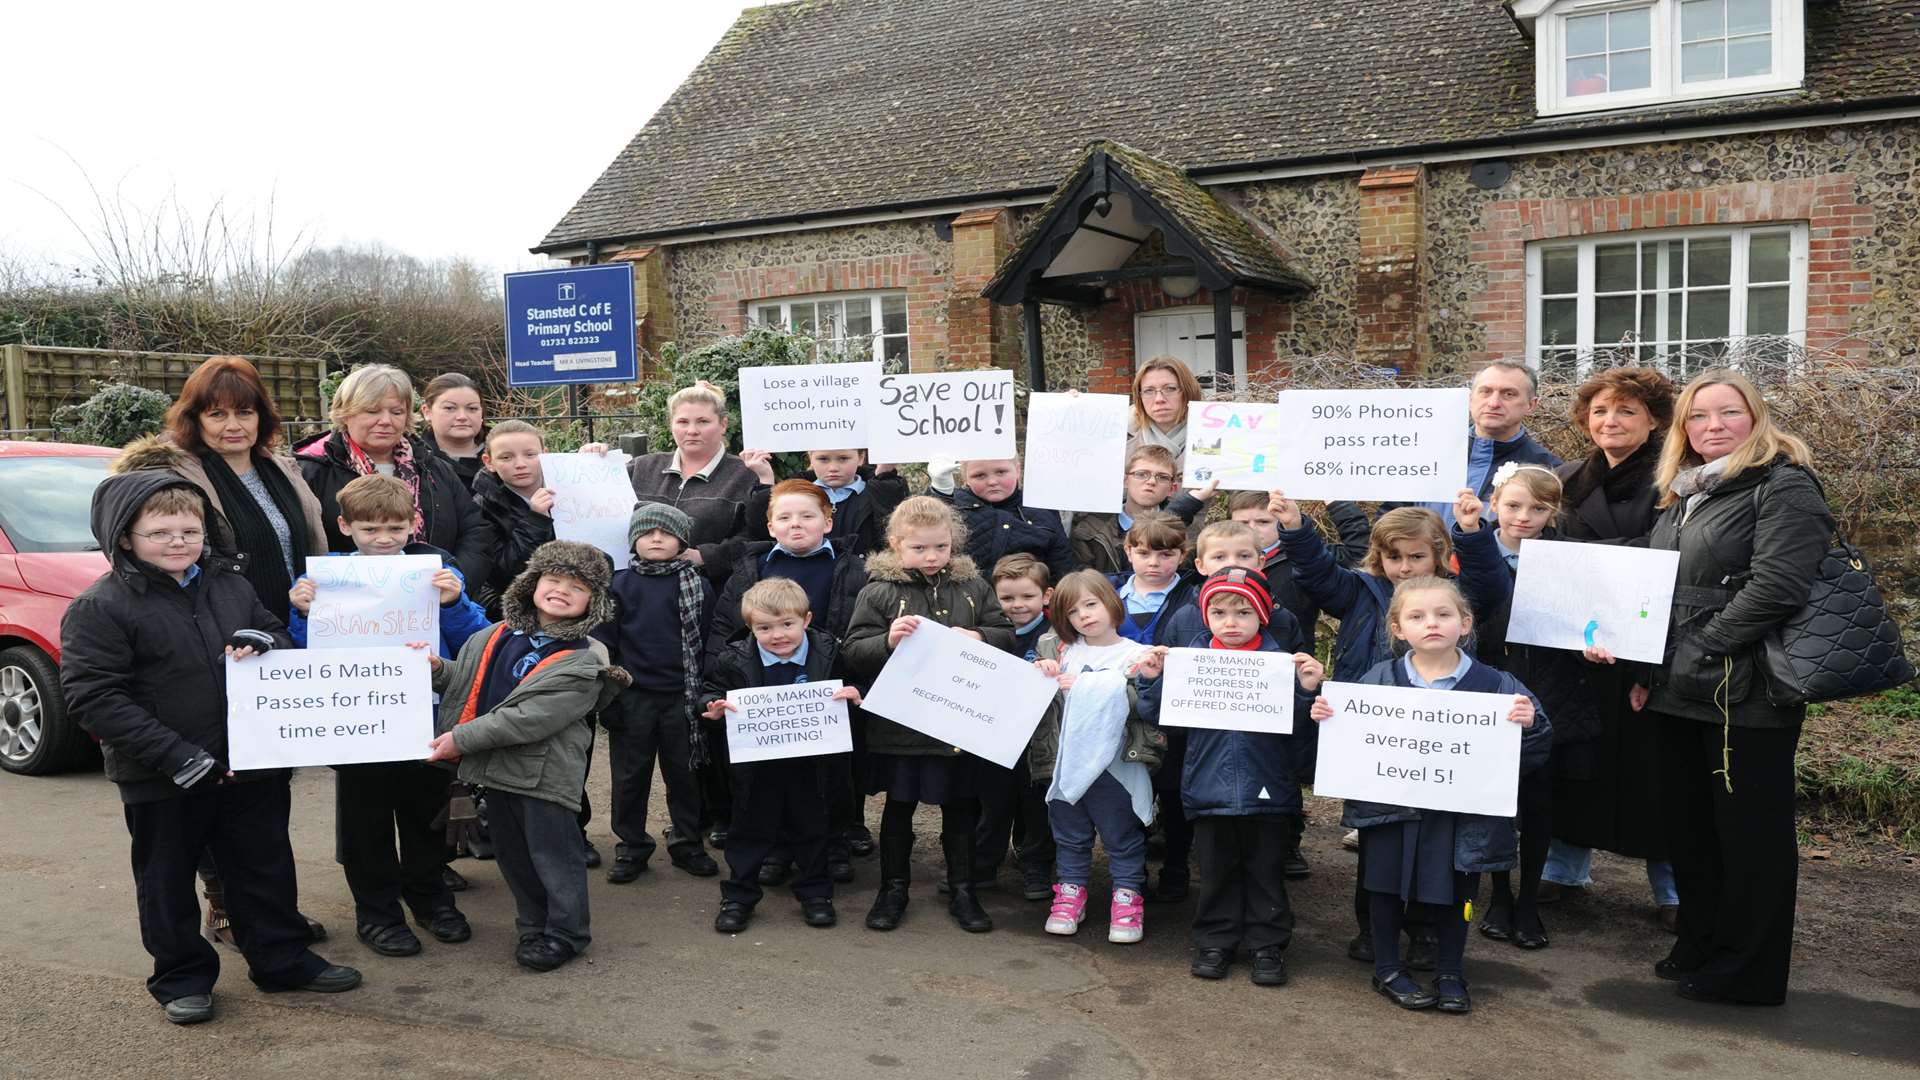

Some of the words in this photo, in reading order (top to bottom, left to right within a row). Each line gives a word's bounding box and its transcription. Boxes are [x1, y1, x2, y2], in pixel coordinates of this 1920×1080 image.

[527, 304, 576, 320] Stansted
[579, 304, 588, 316] C
[590, 303, 602, 315] of
[604, 302, 611, 315] E
[527, 322, 571, 337] Primary
[574, 319, 613, 333] School
[540, 337, 566, 347] 01732
[568, 336, 600, 345] 822323
[763, 378, 796, 390] Lose
[801, 379, 809, 388] a
[813, 375, 860, 389] village
[879, 376, 951, 406] Save
[963, 381, 1011, 402] our
[764, 397, 816, 412] school,
[820, 397, 849, 408] ruin
[854, 398, 862, 407] a
[1311, 405, 1352, 419] 90%
[1359, 404, 1433, 419] Phonics
[772, 418, 857, 432] community
[1324, 434, 1366, 450] pass
[1372, 432, 1419, 447] rate!
[1303, 461, 1344, 476] 68%
[1350, 461, 1438, 476] increase!
[959, 650, 998, 671] ROBBED
[1193, 655, 1216, 664] 48%
[1219, 656, 1265, 667] MAKING
[259, 664, 312, 681] Level
[320, 664, 332, 679] 6
[339, 662, 403, 678] Maths
[1197, 666, 1260, 678] EXPECTED
[951, 675, 965, 684] OF
[966, 680, 982, 691] MY
[1188, 676, 1254, 689] PROGRESS
[1257, 681, 1269, 690] IN
[256, 695, 325, 710] Passes
[331, 692, 361, 707] for
[367, 691, 407, 706] first
[737, 693, 773, 705] 100%
[776, 687, 833, 702] MAKING
[1193, 689, 1244, 700] WRITING
[1246, 692, 1263, 701] AT
[747, 702, 825, 720] EXPECTED
[911, 687, 965, 713] RECEPTION
[964, 704, 995, 725] PLACE
[1171, 698, 1227, 711] OFFERED
[1230, 702, 1283, 714] SCHOOL!
[1344, 699, 1406, 719] Above
[1412, 709, 1497, 727] national
[279, 723, 326, 739] time
[334, 719, 386, 737] ever!
[738, 716, 820, 734] PROGRESS
[824, 714, 838, 725] IN
[756, 730, 823, 746] WRITING!
[1365, 732, 1443, 755] average
[1450, 741, 1471, 755] at
[1376, 761, 1426, 782] Level
[1433, 768, 1454, 785] 5!
